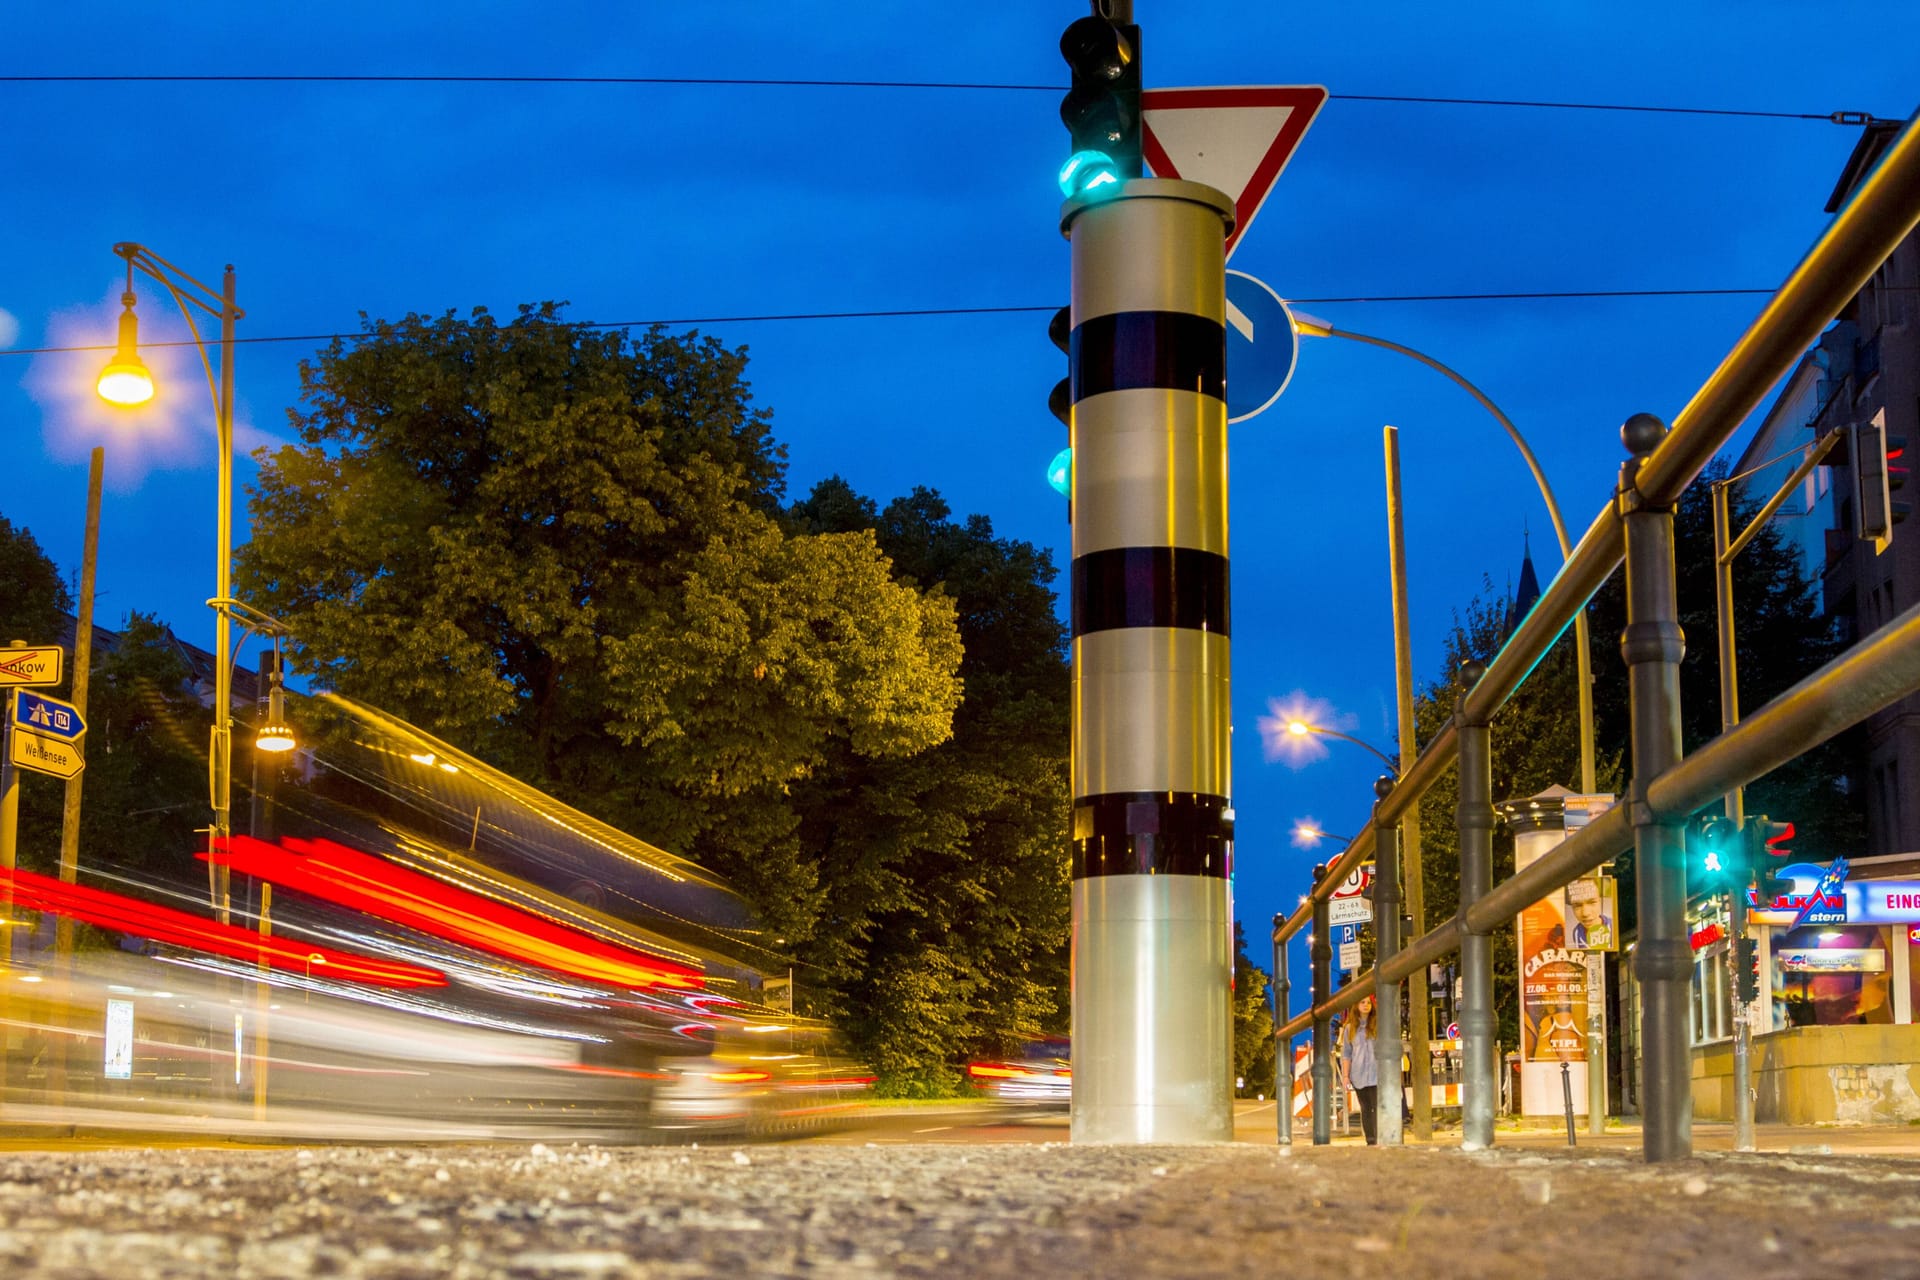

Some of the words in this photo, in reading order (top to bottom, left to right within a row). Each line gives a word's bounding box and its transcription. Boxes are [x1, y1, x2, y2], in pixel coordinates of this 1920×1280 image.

[4, 660, 46, 674] nkow
[57, 713, 67, 727] 114
[25, 741, 68, 766] Weißensee
[1886, 894, 1920, 909] EING
[1809, 913, 1845, 922] stern
[1550, 1039, 1578, 1048] TIPI
